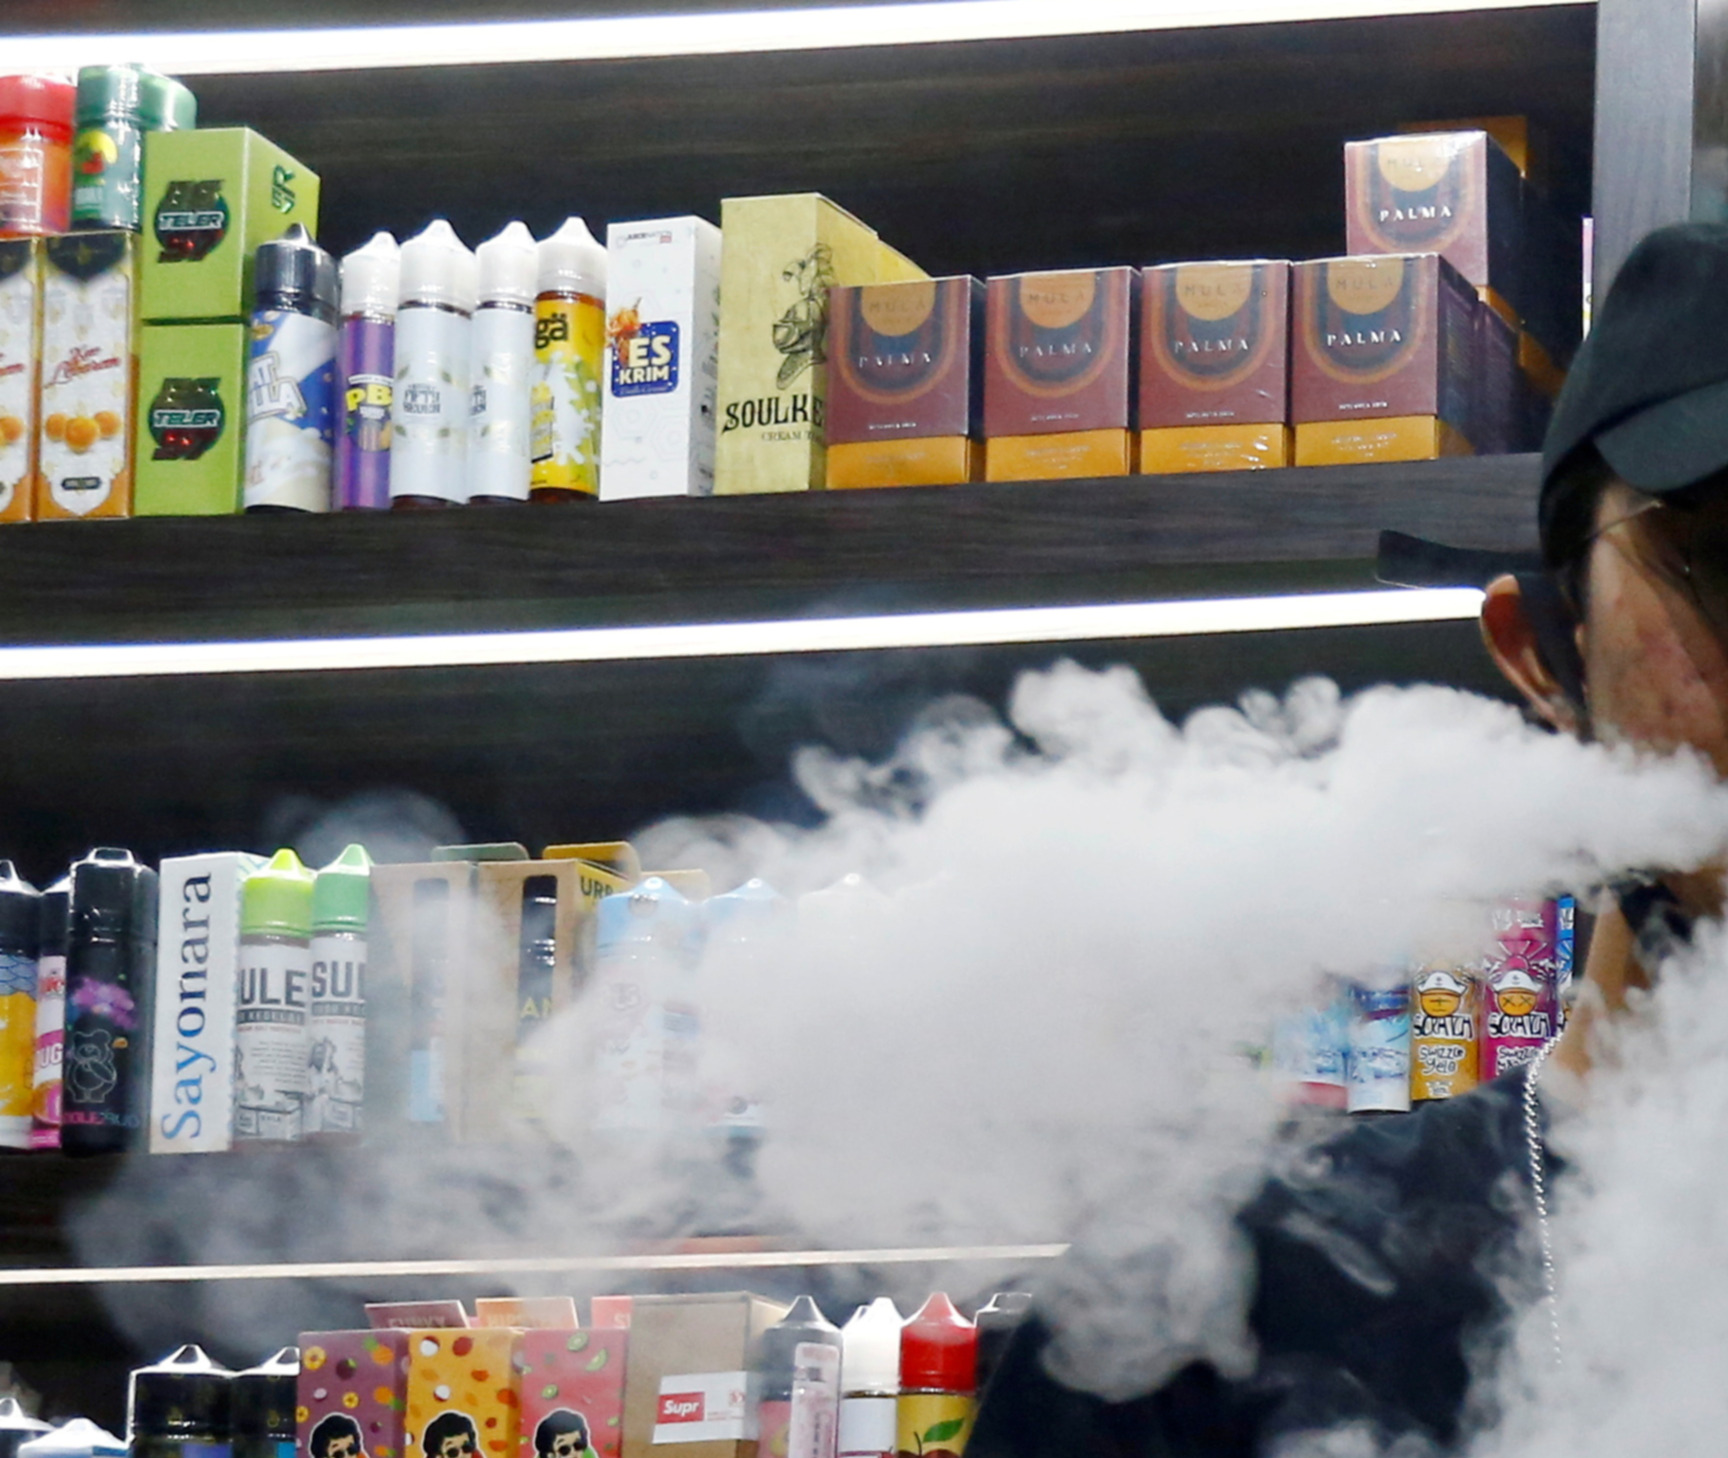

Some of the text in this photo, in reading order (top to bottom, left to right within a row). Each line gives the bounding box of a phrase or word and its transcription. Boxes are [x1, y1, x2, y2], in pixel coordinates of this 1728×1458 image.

[157, 212, 224, 230] TELER
[1380, 206, 1453, 221] PALMA
[1174, 338, 1249, 353] PALMA
[1328, 330, 1402, 346] PALMA
[629, 336, 671, 367] ES
[1020, 342, 1094, 357] PALMA
[858, 353, 931, 368] PALMA
[619, 365, 669, 386] KRIM
[153, 410, 220, 427] TELER
[722, 393, 823, 433] SOULKE
[163, 871, 215, 1141] Sayonara
[663, 1399, 700, 1417] Supr
